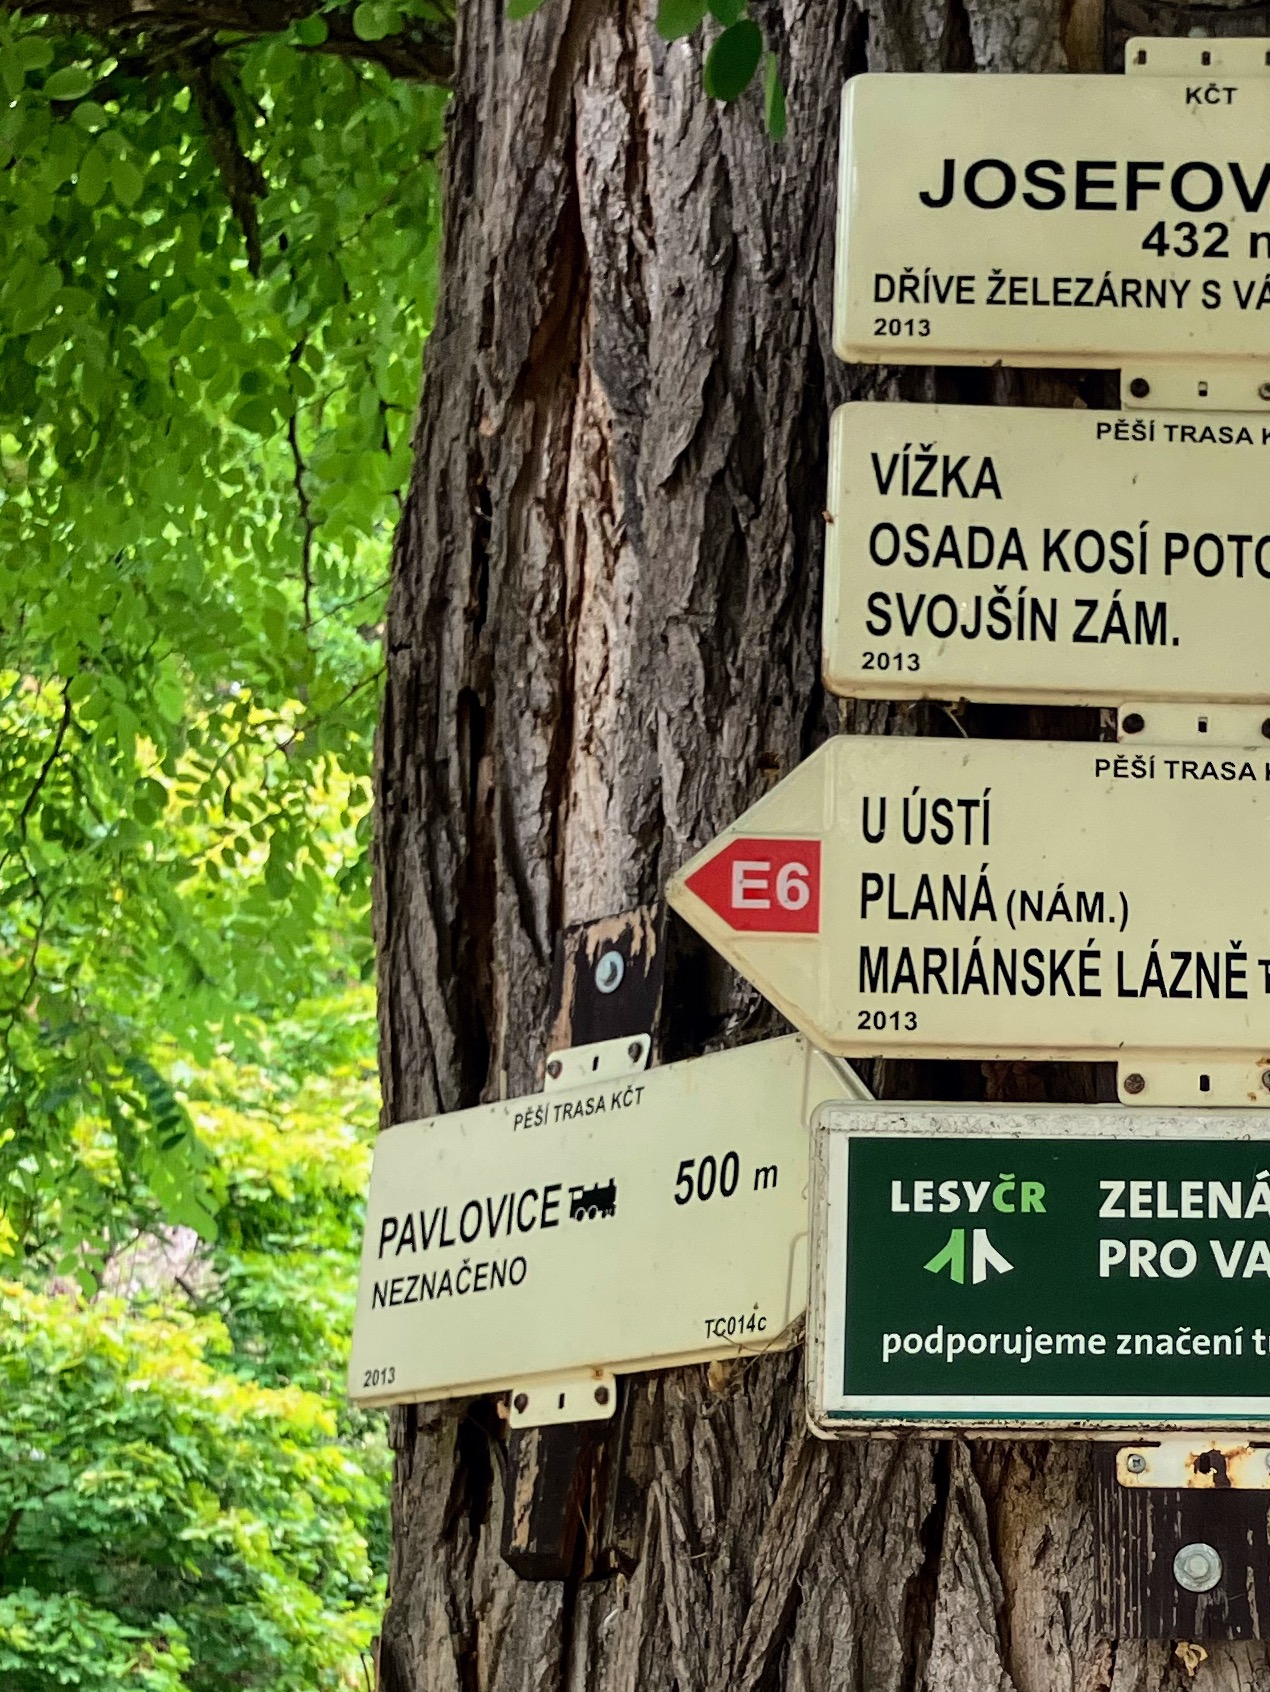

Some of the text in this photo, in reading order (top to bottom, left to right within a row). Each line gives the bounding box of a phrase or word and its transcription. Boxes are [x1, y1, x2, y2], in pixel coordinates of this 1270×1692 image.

[1185, 82, 1238, 105] KČT
[1141, 220, 1229, 258] 432
[874, 266, 976, 305] DŘÍVE
[986, 268, 1191, 309] ŽELEZÁRNY
[1201, 279, 1222, 310] S
[873, 318, 931, 337] 2013
[1096, 418, 1155, 442] PĚŠÍ
[1163, 424, 1254, 445] TRASA
[870, 442, 1003, 500] VÍŽKA
[869, 522, 1029, 571] OSADA
[1043, 520, 1150, 575] KOSÍ
[865, 584, 1058, 642] SVOJŠÍN
[1072, 588, 1179, 647] ZÁM.
[861, 651, 920, 672] 2013
[1095, 754, 1155, 779] PĚŠÍ
[1163, 760, 1257, 781] TRASA
[862, 796, 887, 844] U
[902, 785, 992, 846] ÚSTÍ
[731, 860, 810, 911] E6
[860, 862, 998, 922] PLANÁ
[1006, 882, 1129, 933] (NÁM.)
[859, 935, 1102, 998] MARIÁNSKÉ
[1117, 938, 1248, 1000] LÁZNĚ
[857, 1010, 918, 1031] 2013
[513, 1084, 645, 1132] PĚŠÍ TRASA KČT
[377, 1150, 778, 1259] PAVLOVICE 500 m
[1099, 1239, 1198, 1279] PRO
[371, 1256, 527, 1309] NEZNAČENO
[704, 1313, 767, 1339] TC014c
[882, 1324, 1107, 1364] podporujeme
[1116, 1326, 1244, 1356] značení
[363, 1366, 396, 1388] 2013
